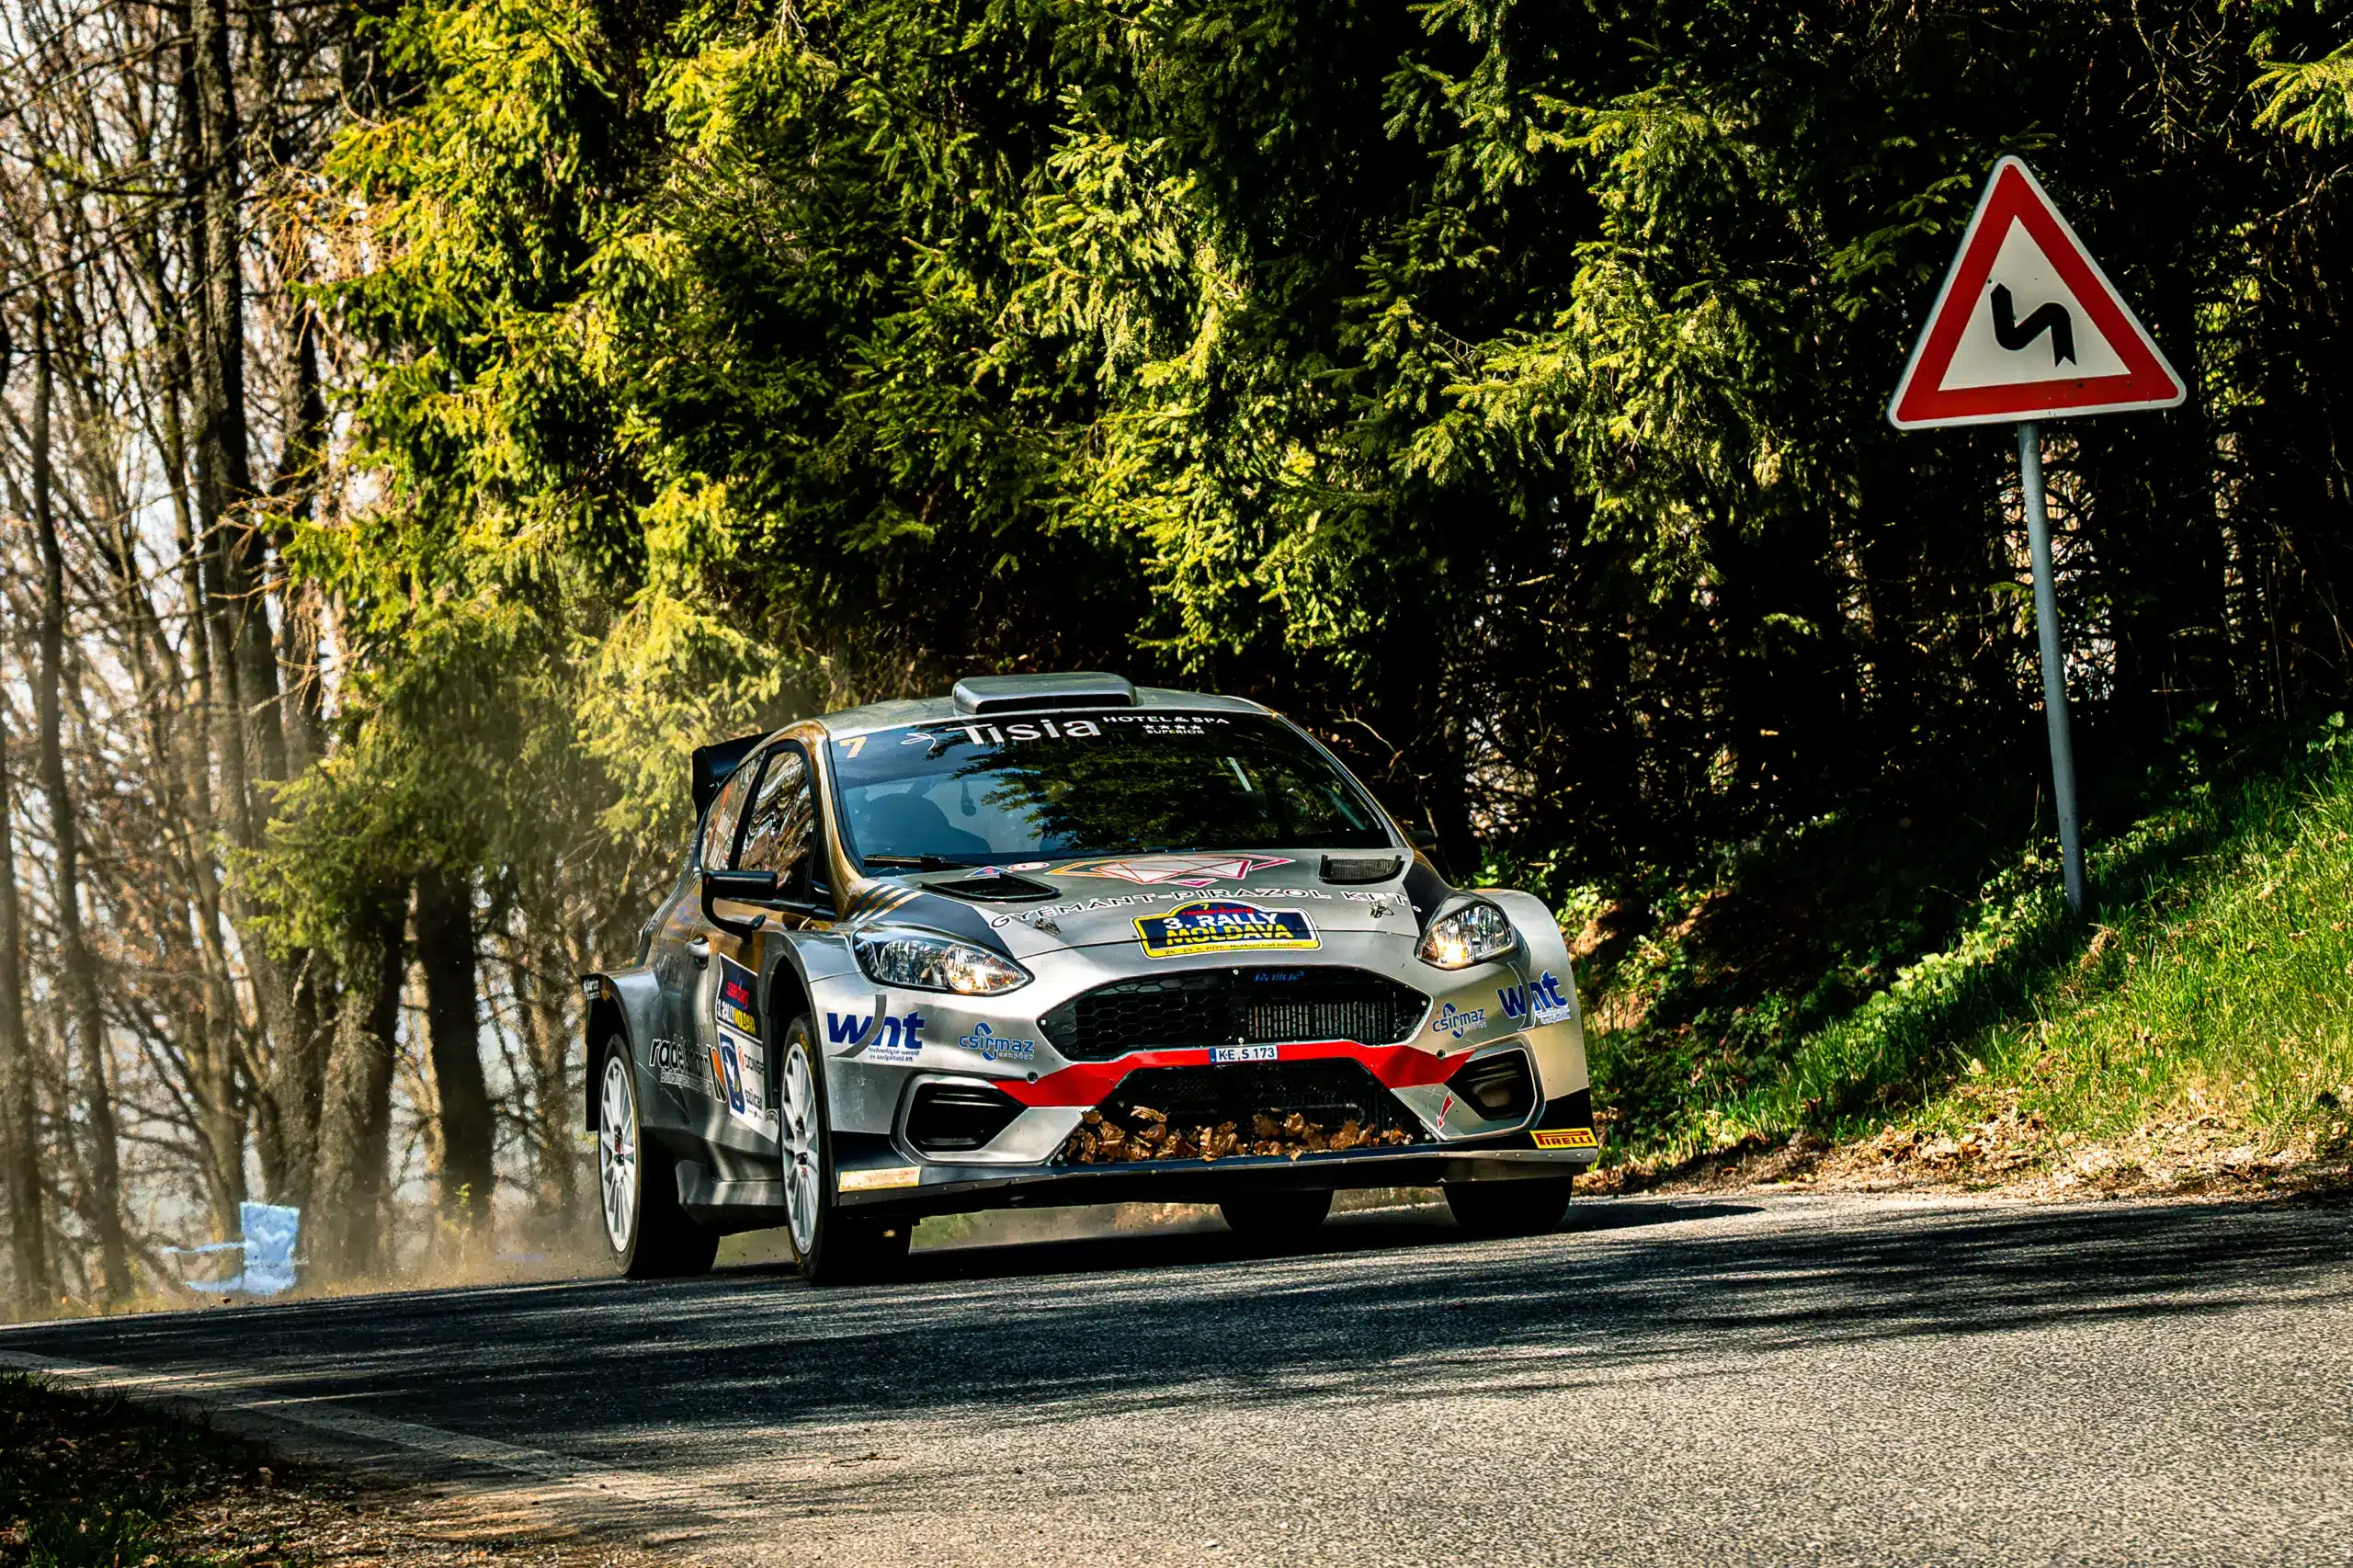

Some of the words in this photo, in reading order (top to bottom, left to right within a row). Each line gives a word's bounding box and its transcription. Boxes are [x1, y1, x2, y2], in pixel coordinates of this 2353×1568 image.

[945, 719, 1102, 745] Tisia
[839, 736, 867, 759] 7
[1163, 917, 1192, 929] 3.
[1197, 913, 1278, 927] RALLY
[1166, 924, 1294, 946] MOLDAVA
[1432, 1007, 1486, 1033] csirmaz
[958, 1033, 1035, 1054] csirmaz
[1254, 1048, 1275, 1058] 173
[1535, 1131, 1593, 1145] PIRELLI
